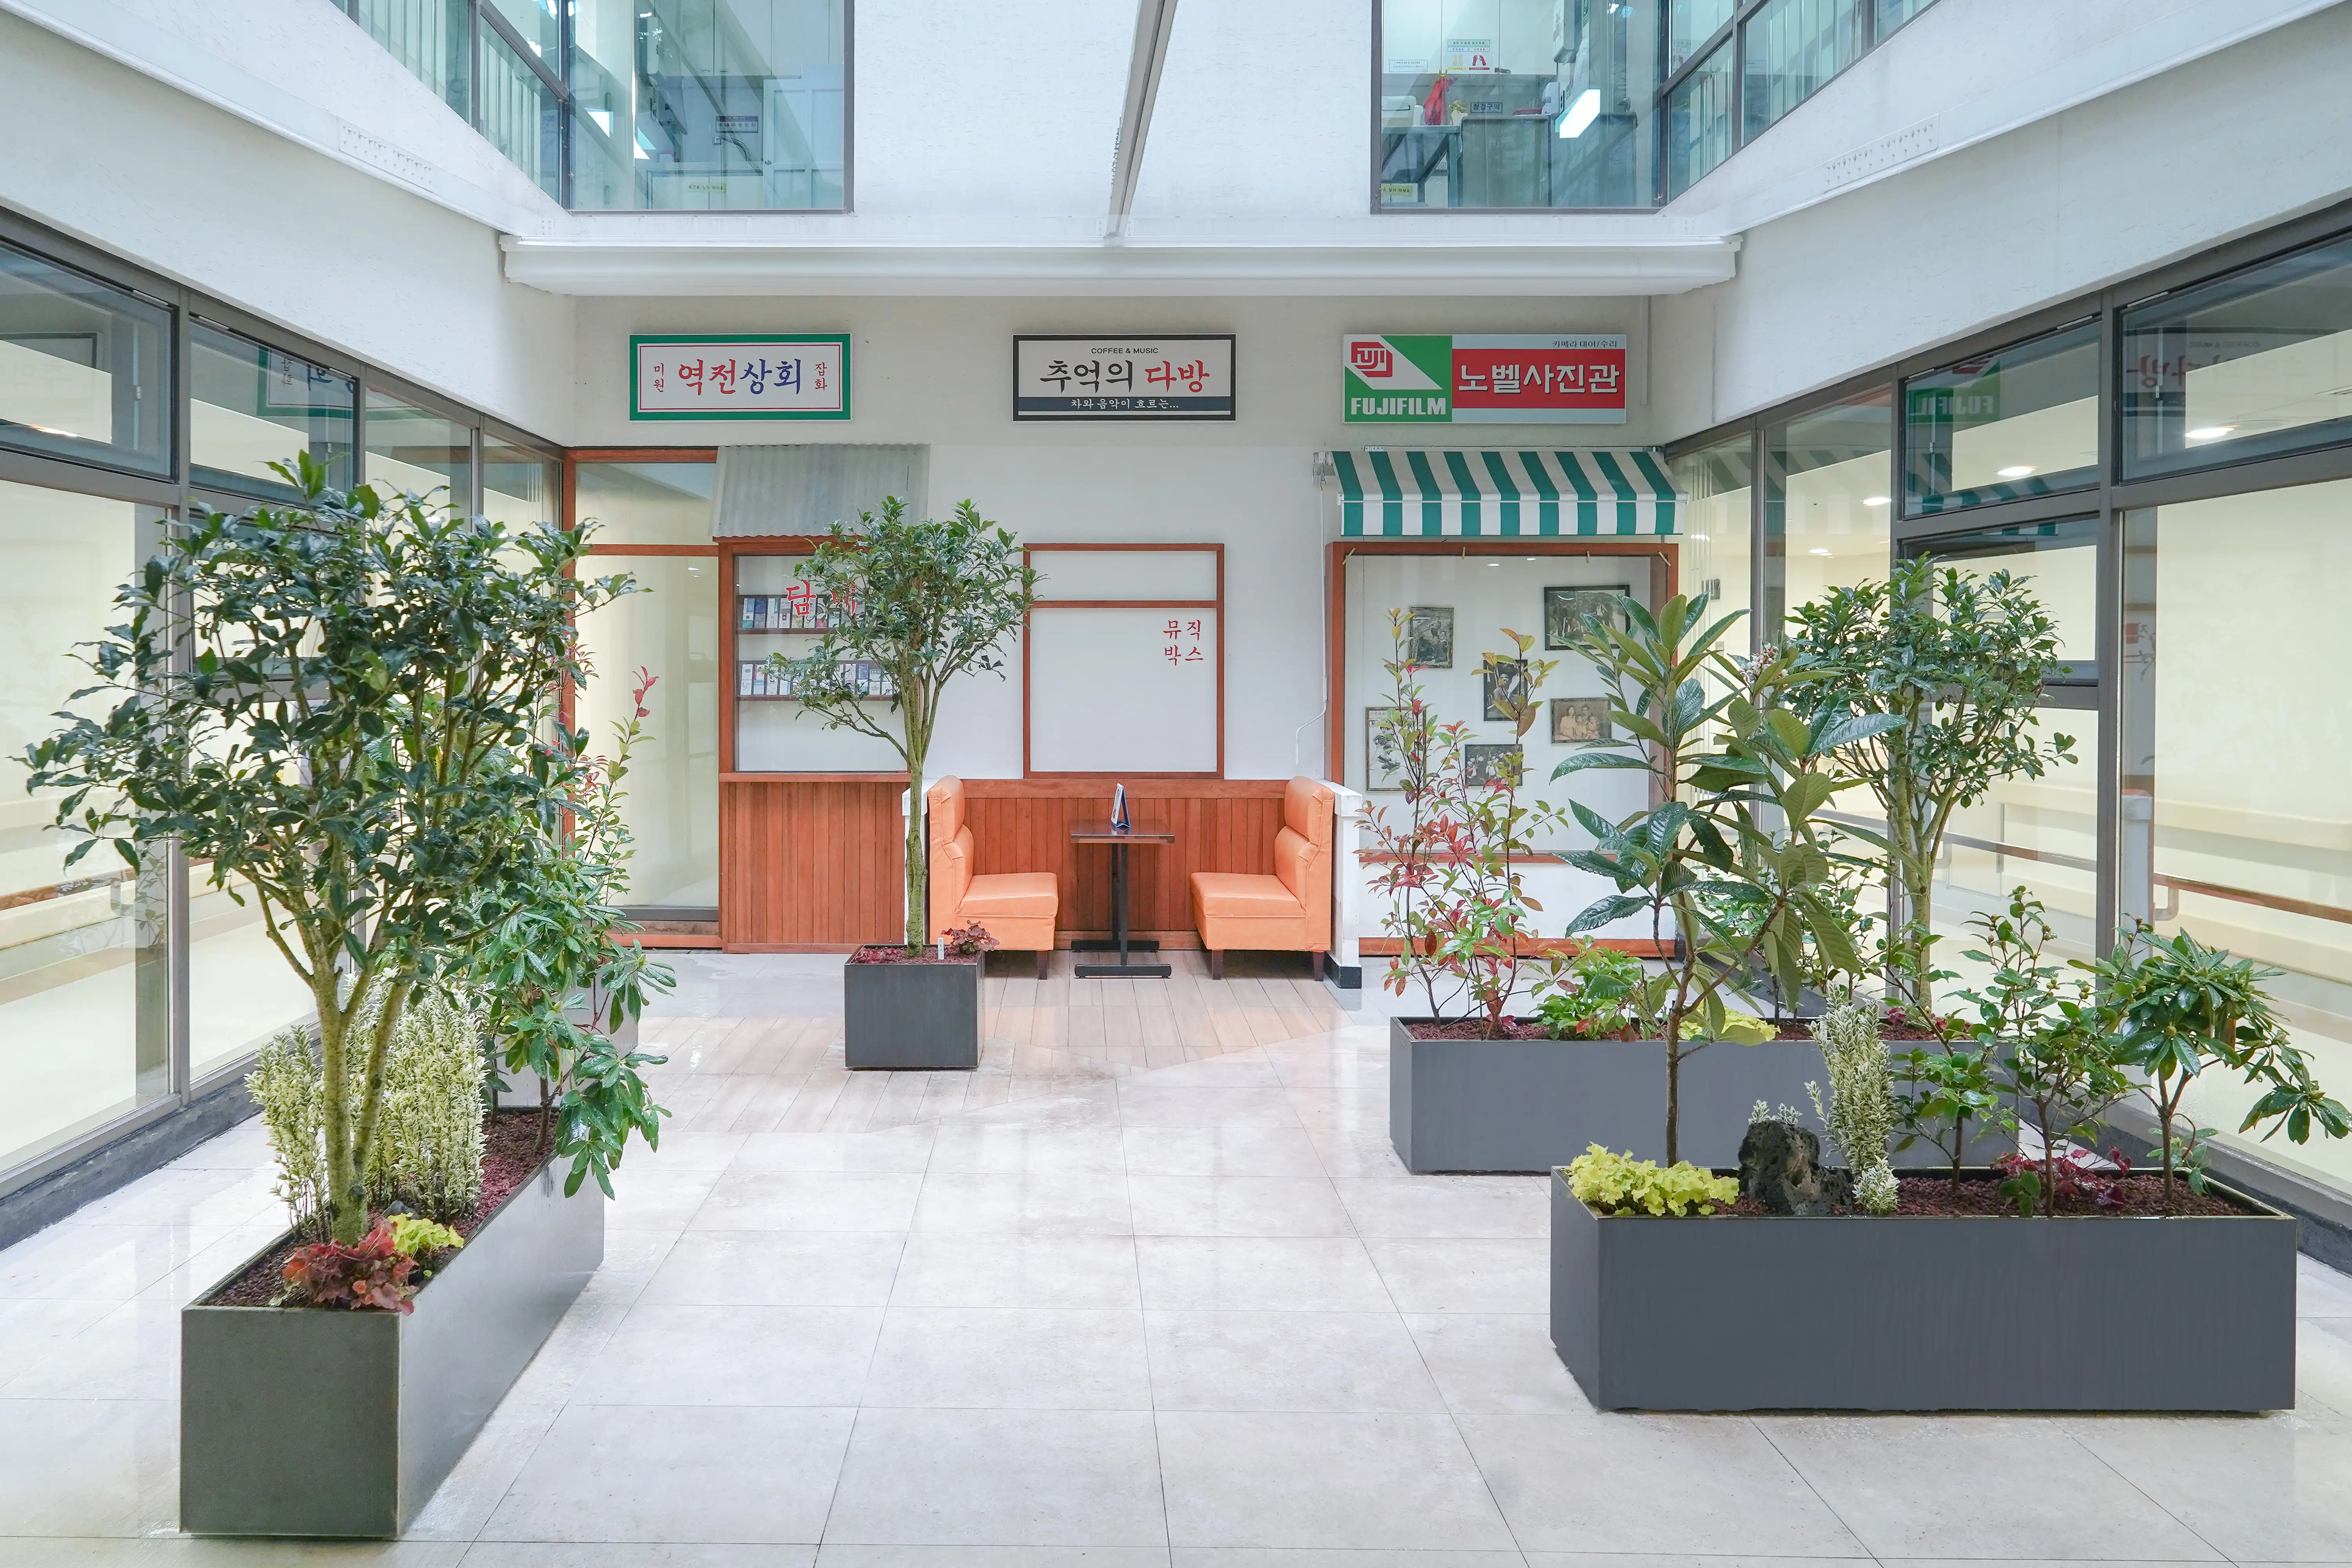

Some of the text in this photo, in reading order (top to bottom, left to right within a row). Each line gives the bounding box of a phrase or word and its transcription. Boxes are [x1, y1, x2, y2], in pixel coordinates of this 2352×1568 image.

[1552, 340, 1617, 348] 카메라 대여/수리
[1351, 342, 1393, 377] FUJI
[653, 362, 664, 392] 미원
[679, 358, 801, 396] 역전상회
[814, 362, 828, 391] 잡화
[1040, 359, 1210, 394] 추억의 다방
[1458, 364, 1620, 394] 노벨사진관
[1071, 398, 1179, 409] 차와 음악이 흐르는...
[1351, 397, 1446, 415] FUJIFILM
[1163, 620, 1201, 641] 뮤직
[1164, 645, 1203, 666] 박스
